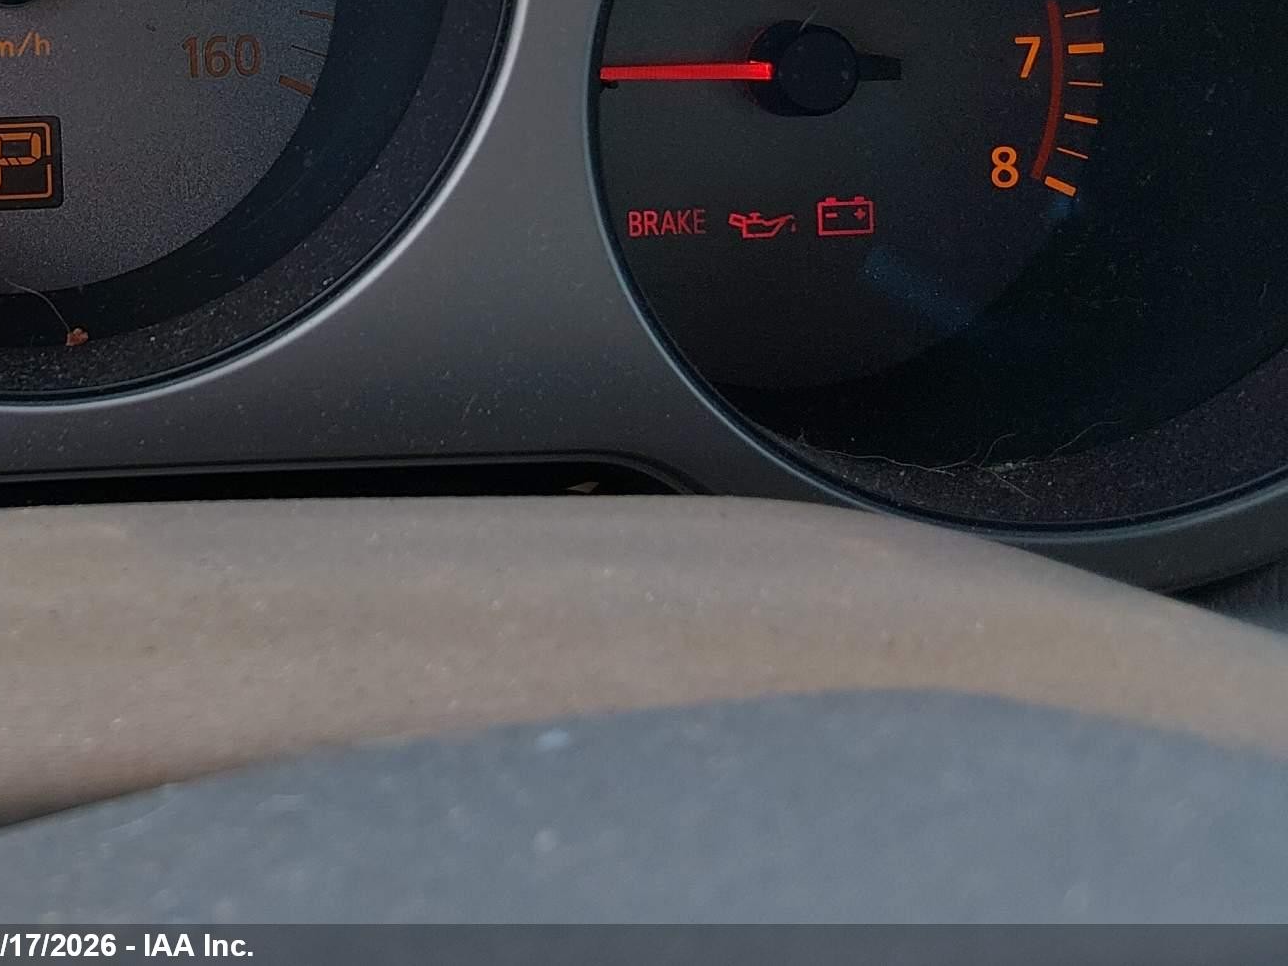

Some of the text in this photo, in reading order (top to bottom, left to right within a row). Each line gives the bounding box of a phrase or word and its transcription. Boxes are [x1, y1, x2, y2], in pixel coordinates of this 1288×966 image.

[182, 35, 262, 78] 160
[1015, 36, 1041, 79] 7
[990, 146, 1018, 188] 8
[628, 209, 706, 237] BRAKE
